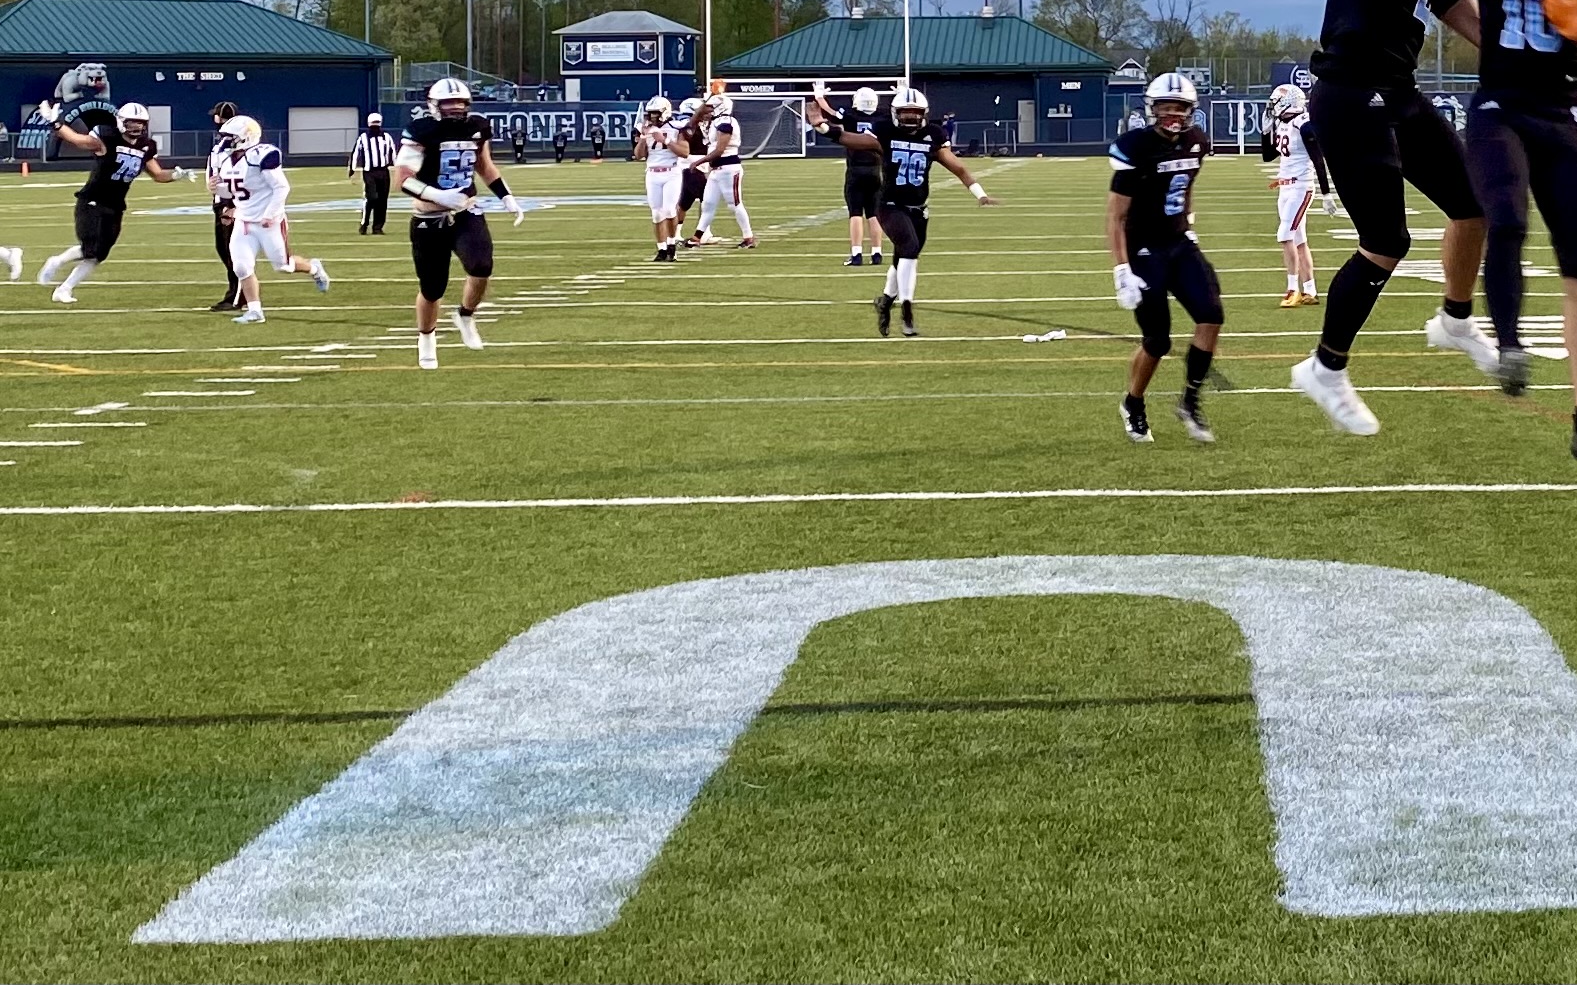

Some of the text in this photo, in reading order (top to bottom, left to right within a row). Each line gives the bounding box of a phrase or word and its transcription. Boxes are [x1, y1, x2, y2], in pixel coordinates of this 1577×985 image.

[176, 72, 224, 81] THE SHED
[740, 85, 775, 93] WOMEN
[1061, 82, 1081, 90] MEN
[891, 150, 927, 187] 70
[223, 178, 251, 201] 75
